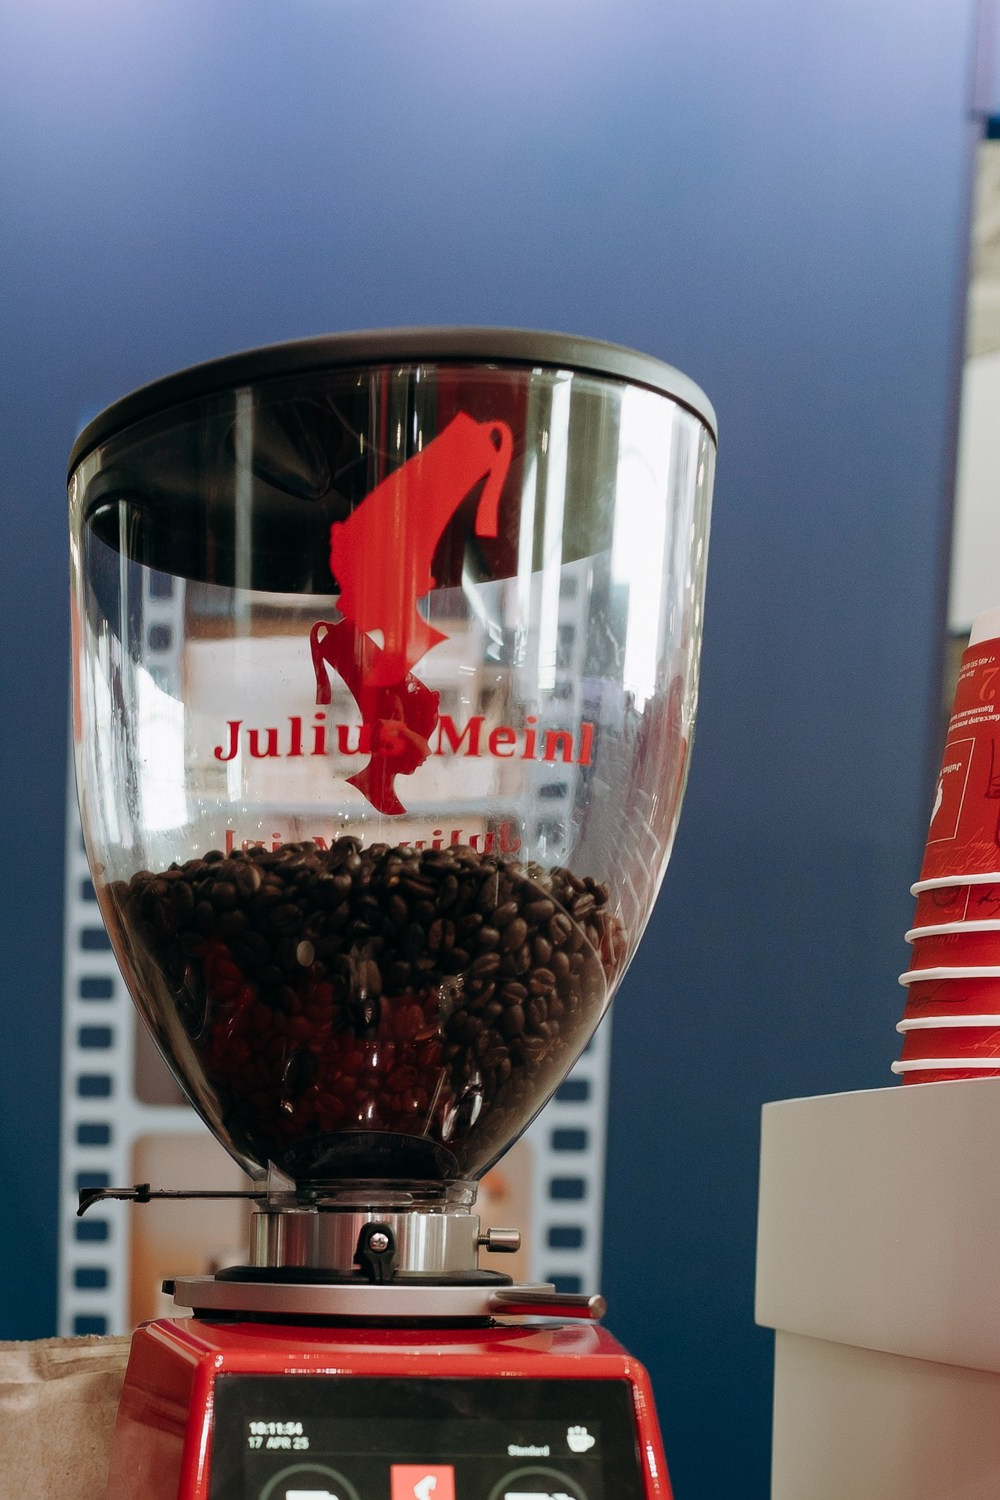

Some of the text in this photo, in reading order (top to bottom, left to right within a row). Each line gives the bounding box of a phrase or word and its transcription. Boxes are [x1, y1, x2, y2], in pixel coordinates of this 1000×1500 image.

[214, 712, 594, 767] Julius Meinl
[248, 1436, 263, 1449] 17
[266, 1436, 291, 1449] APR
